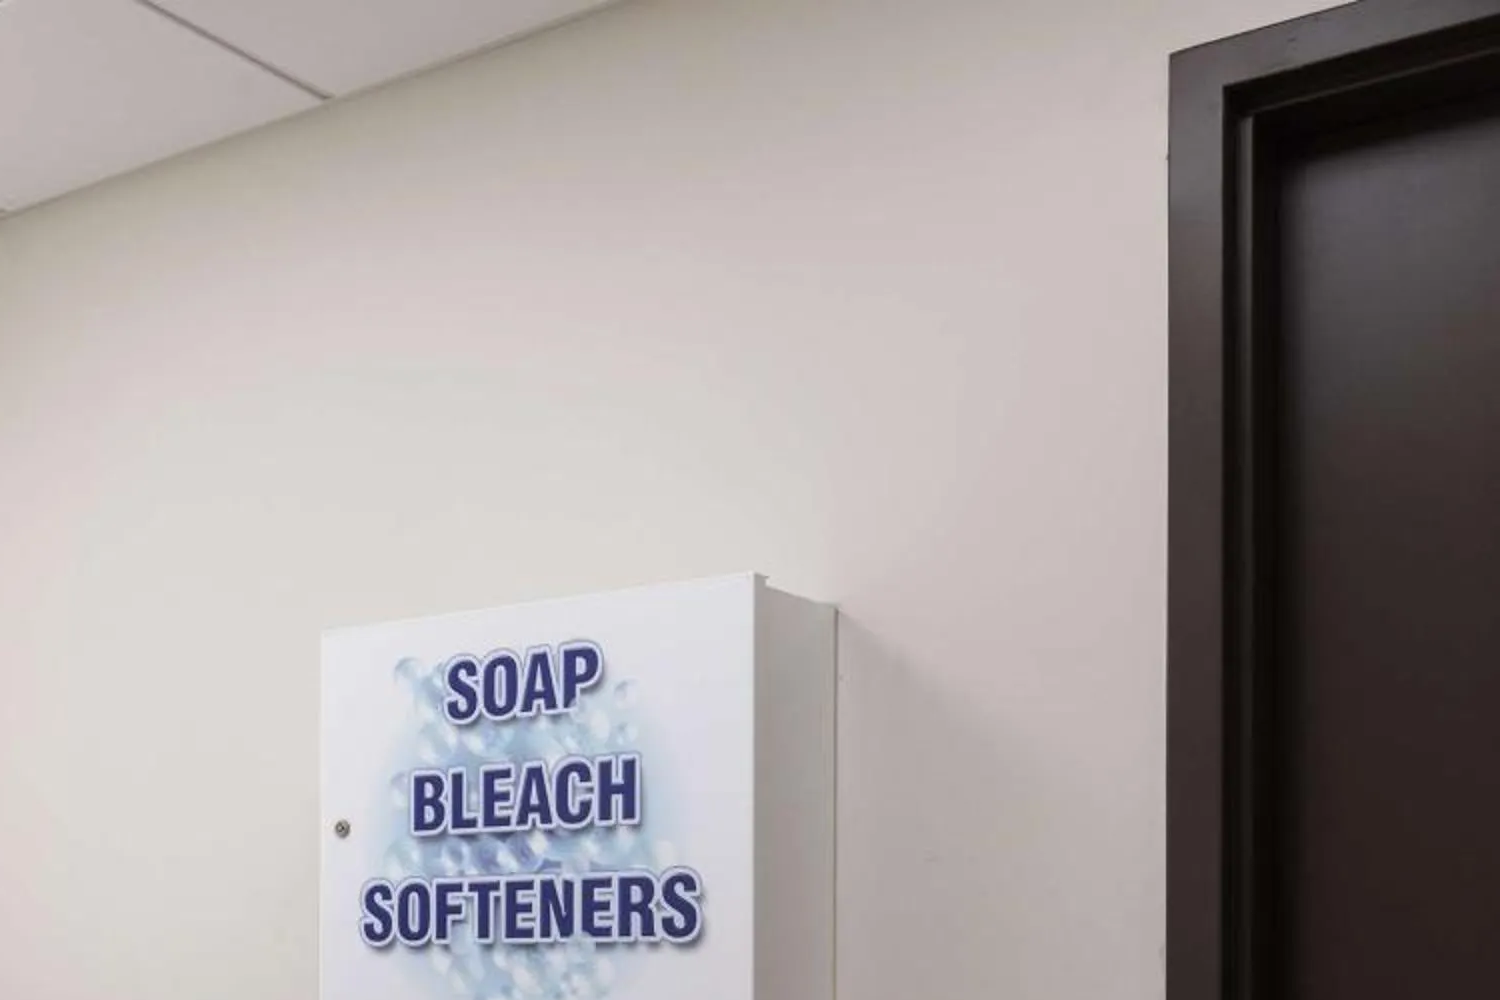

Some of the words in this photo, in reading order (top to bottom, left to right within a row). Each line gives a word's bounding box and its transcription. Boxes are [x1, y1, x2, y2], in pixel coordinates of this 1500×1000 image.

[445, 641, 601, 723] SOAP
[411, 754, 640, 835] BLEACH
[361, 869, 702, 946] SOFTENERS
